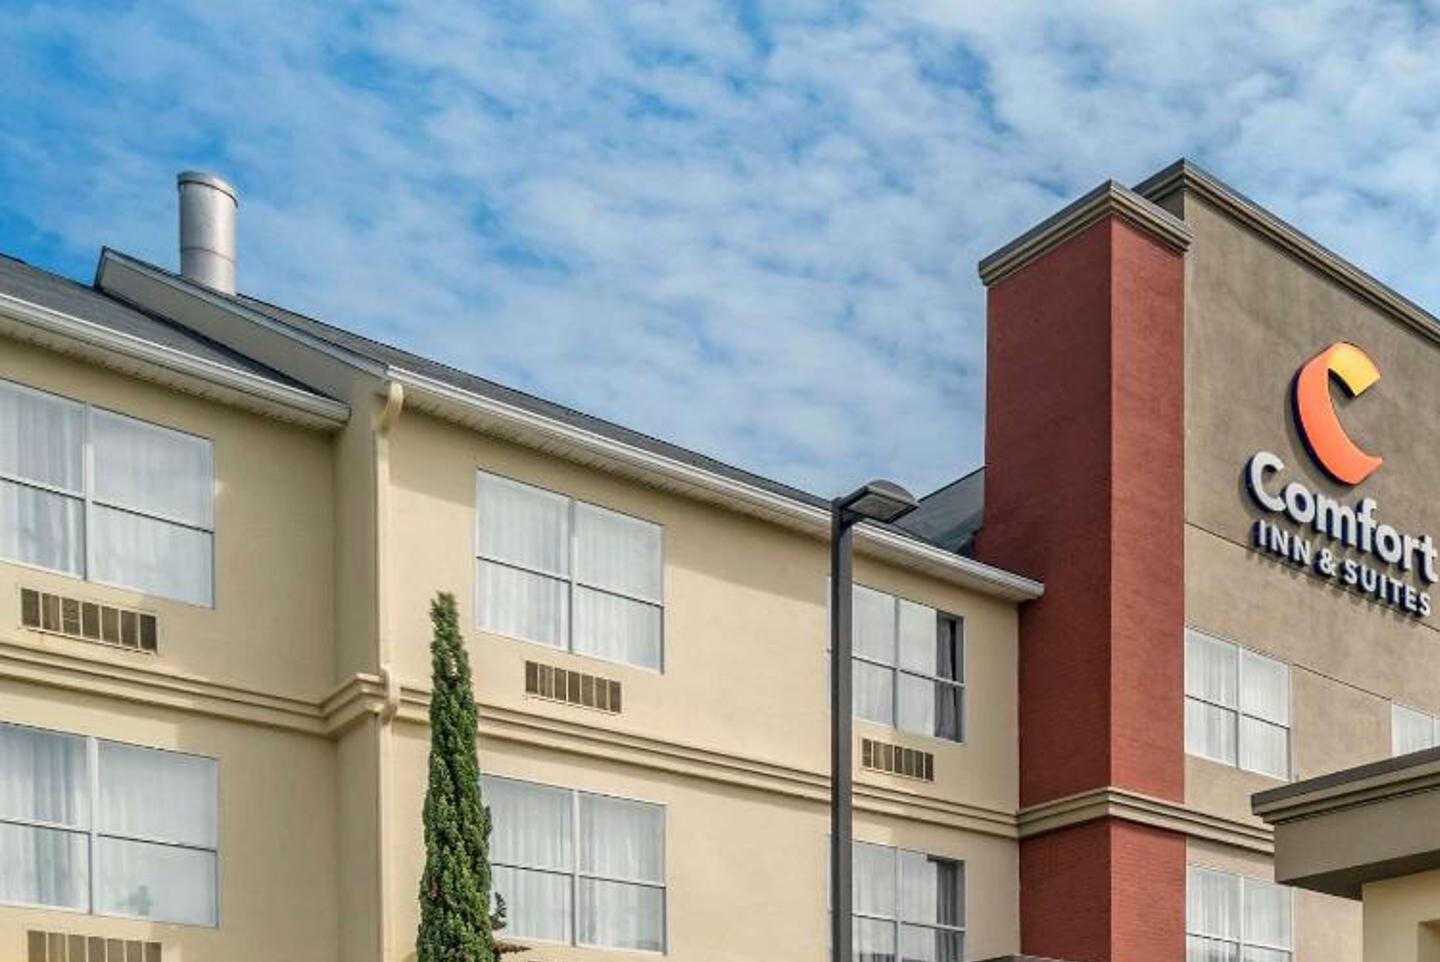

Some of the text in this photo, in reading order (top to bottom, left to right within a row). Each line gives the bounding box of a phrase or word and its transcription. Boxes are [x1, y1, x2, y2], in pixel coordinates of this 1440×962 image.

[1250, 451, 1438, 583] Comfort
[1258, 519, 1432, 617] INN & SUITES
